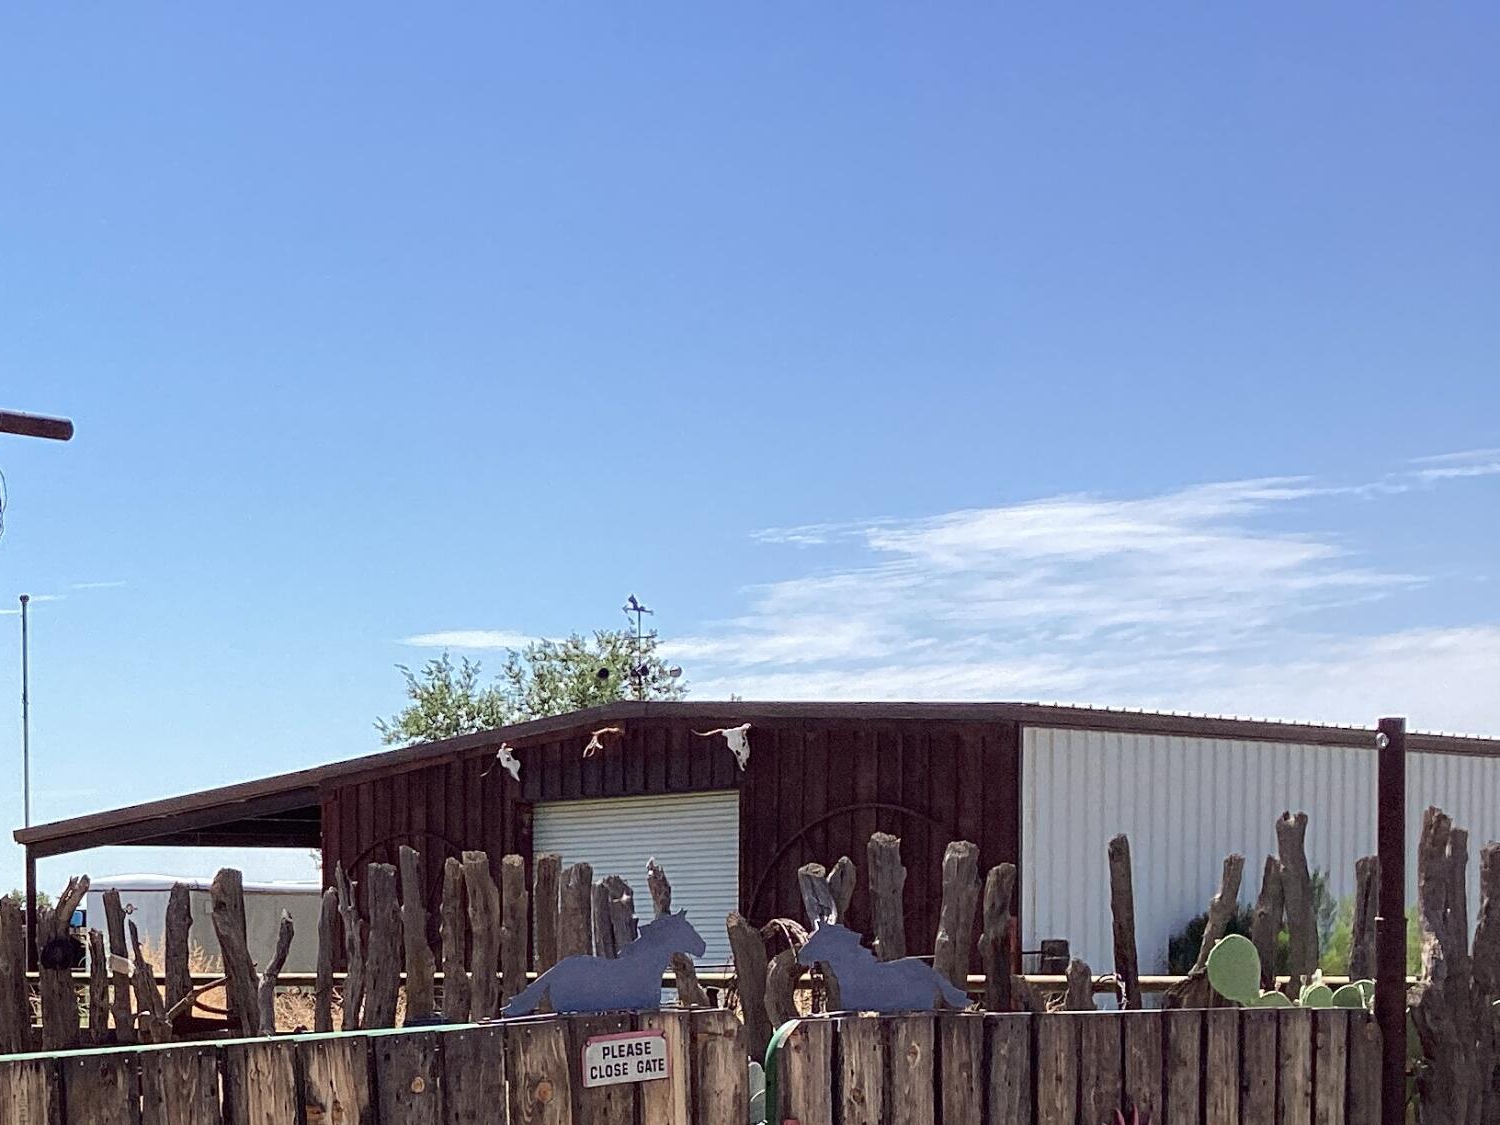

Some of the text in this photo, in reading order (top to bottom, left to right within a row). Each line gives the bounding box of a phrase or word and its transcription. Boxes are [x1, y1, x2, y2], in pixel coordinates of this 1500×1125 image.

[602, 1041, 651, 1060] PLEASE
[590, 1058, 665, 1080] CLOSE GATE
